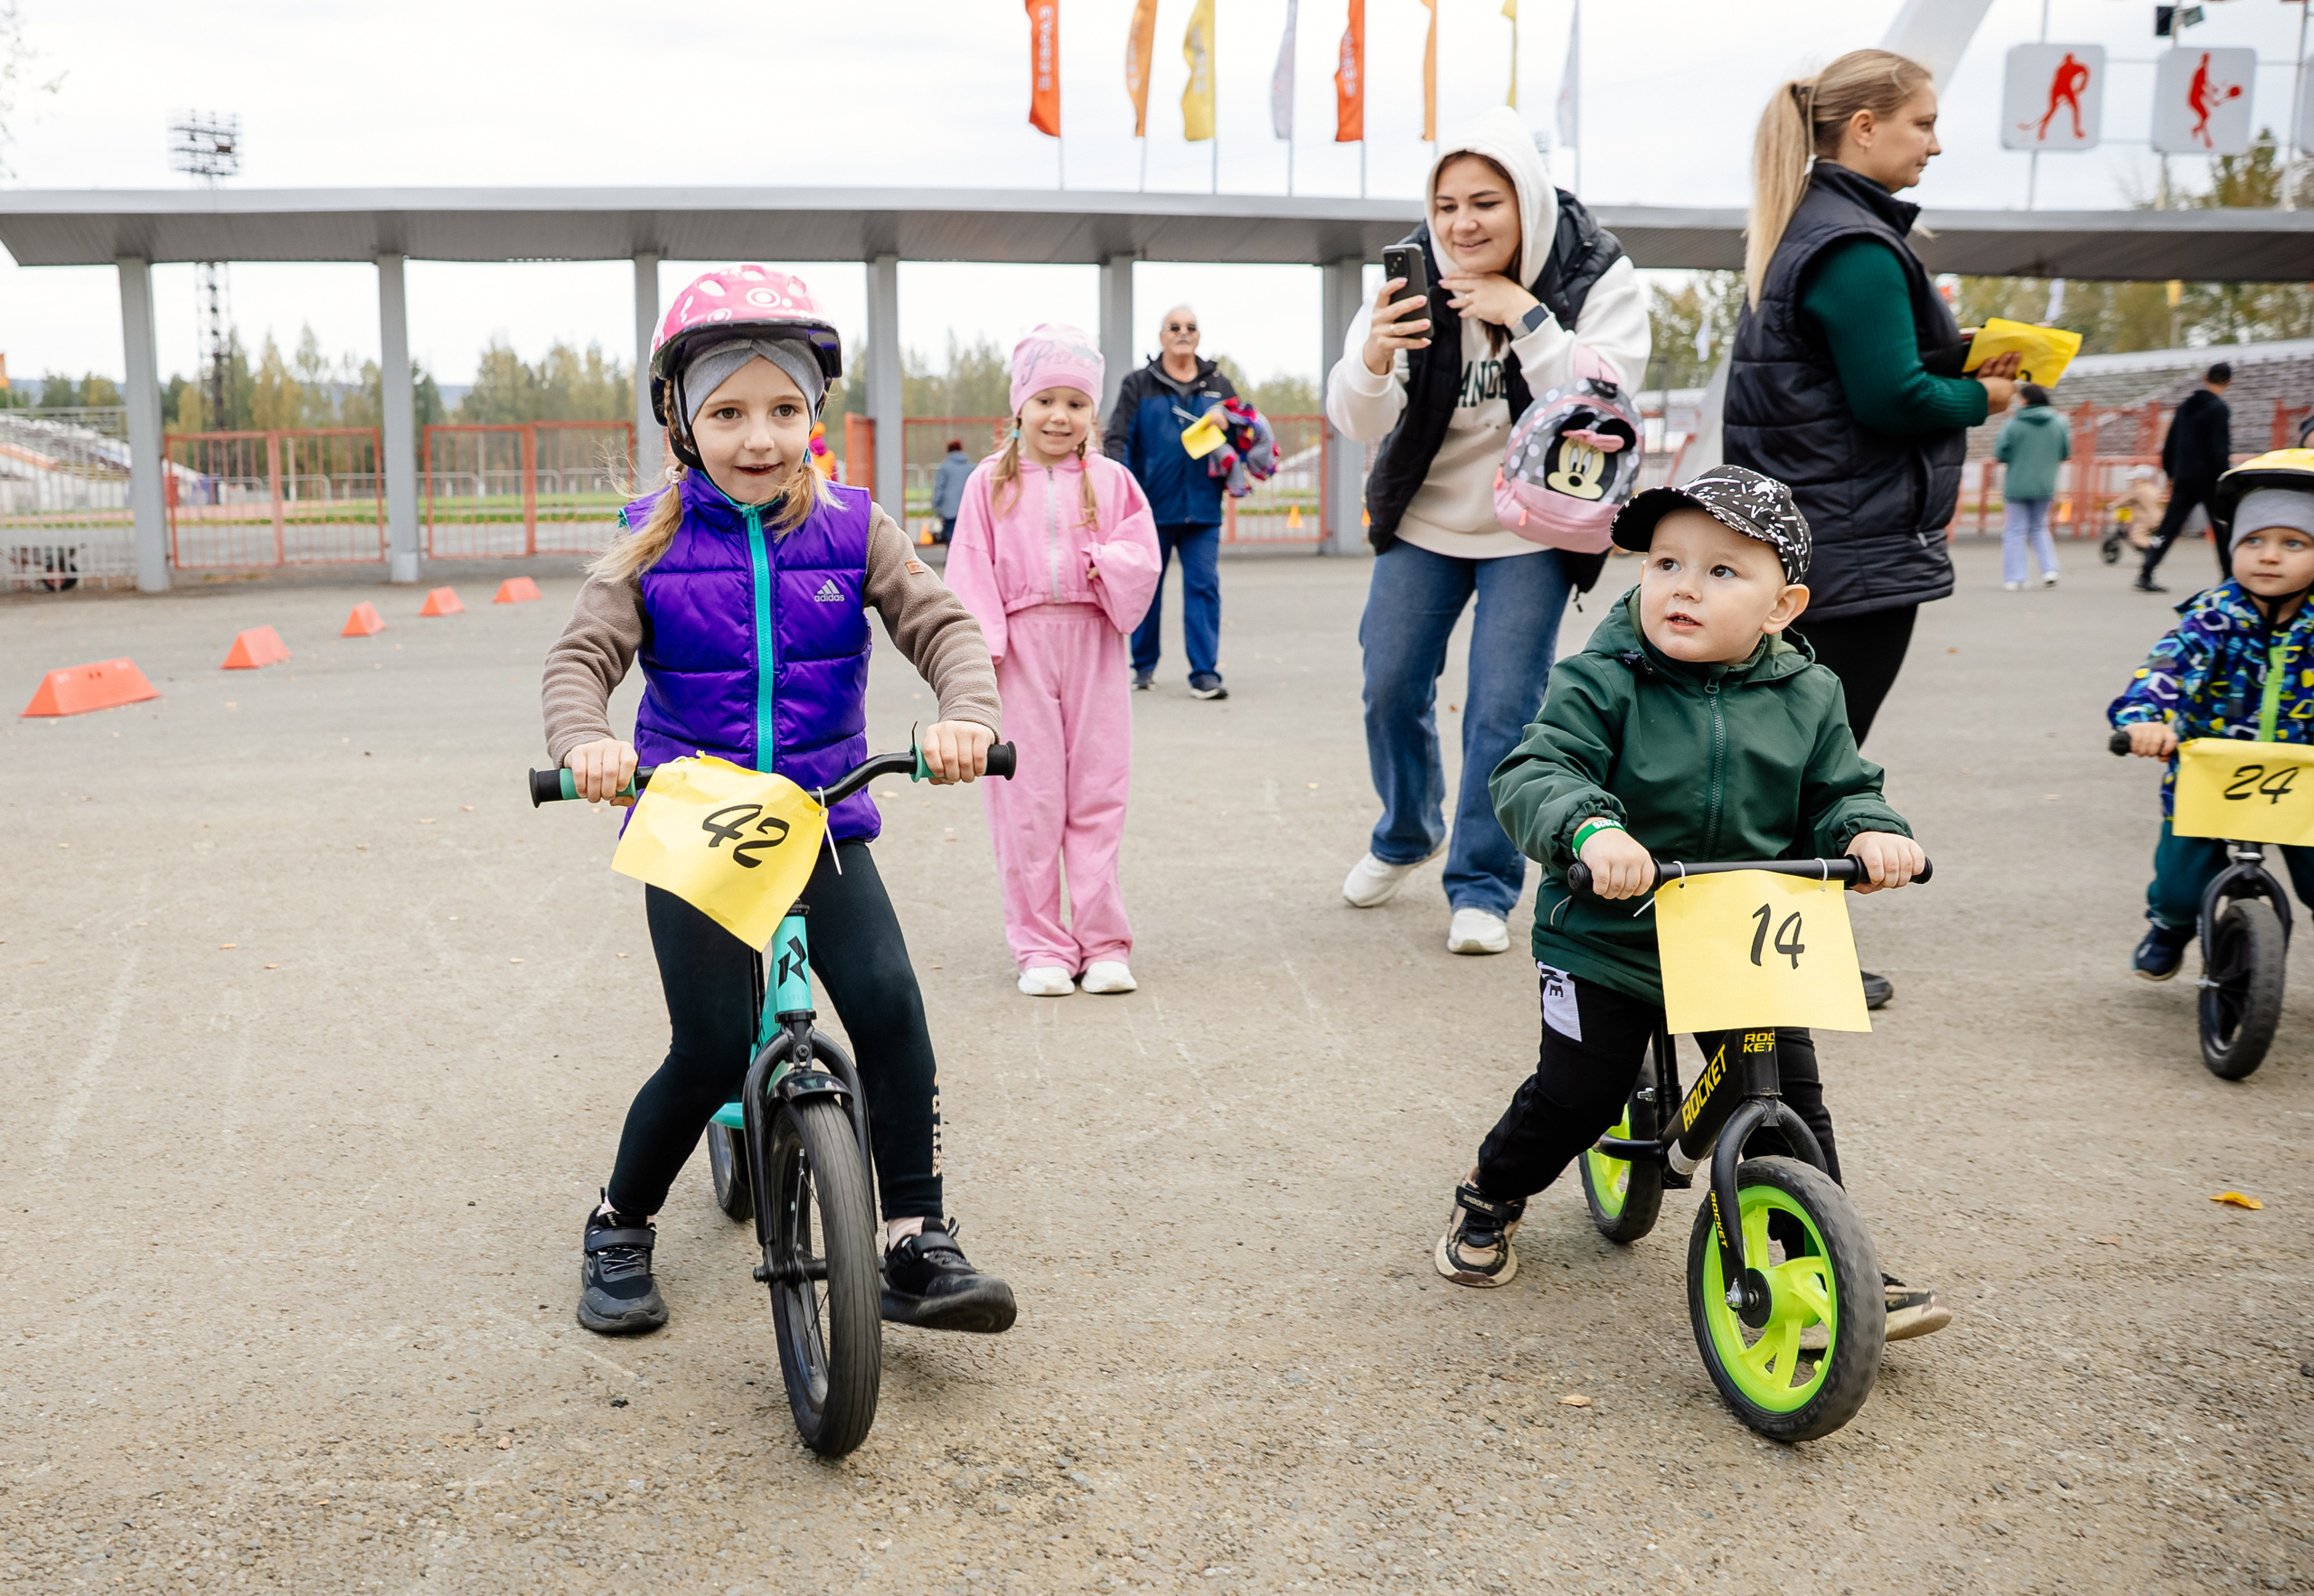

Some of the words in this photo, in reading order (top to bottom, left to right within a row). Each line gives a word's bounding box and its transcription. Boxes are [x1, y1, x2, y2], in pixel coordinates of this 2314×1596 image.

[814, 593, 845, 602] adidas
[2224, 765, 2299, 804] 24
[702, 803, 790, 868] 42
[1750, 903, 1805, 970] 14
[1681, 1044, 1726, 1132] ROCKET
[1710, 1191, 1728, 1249] ROCKET
